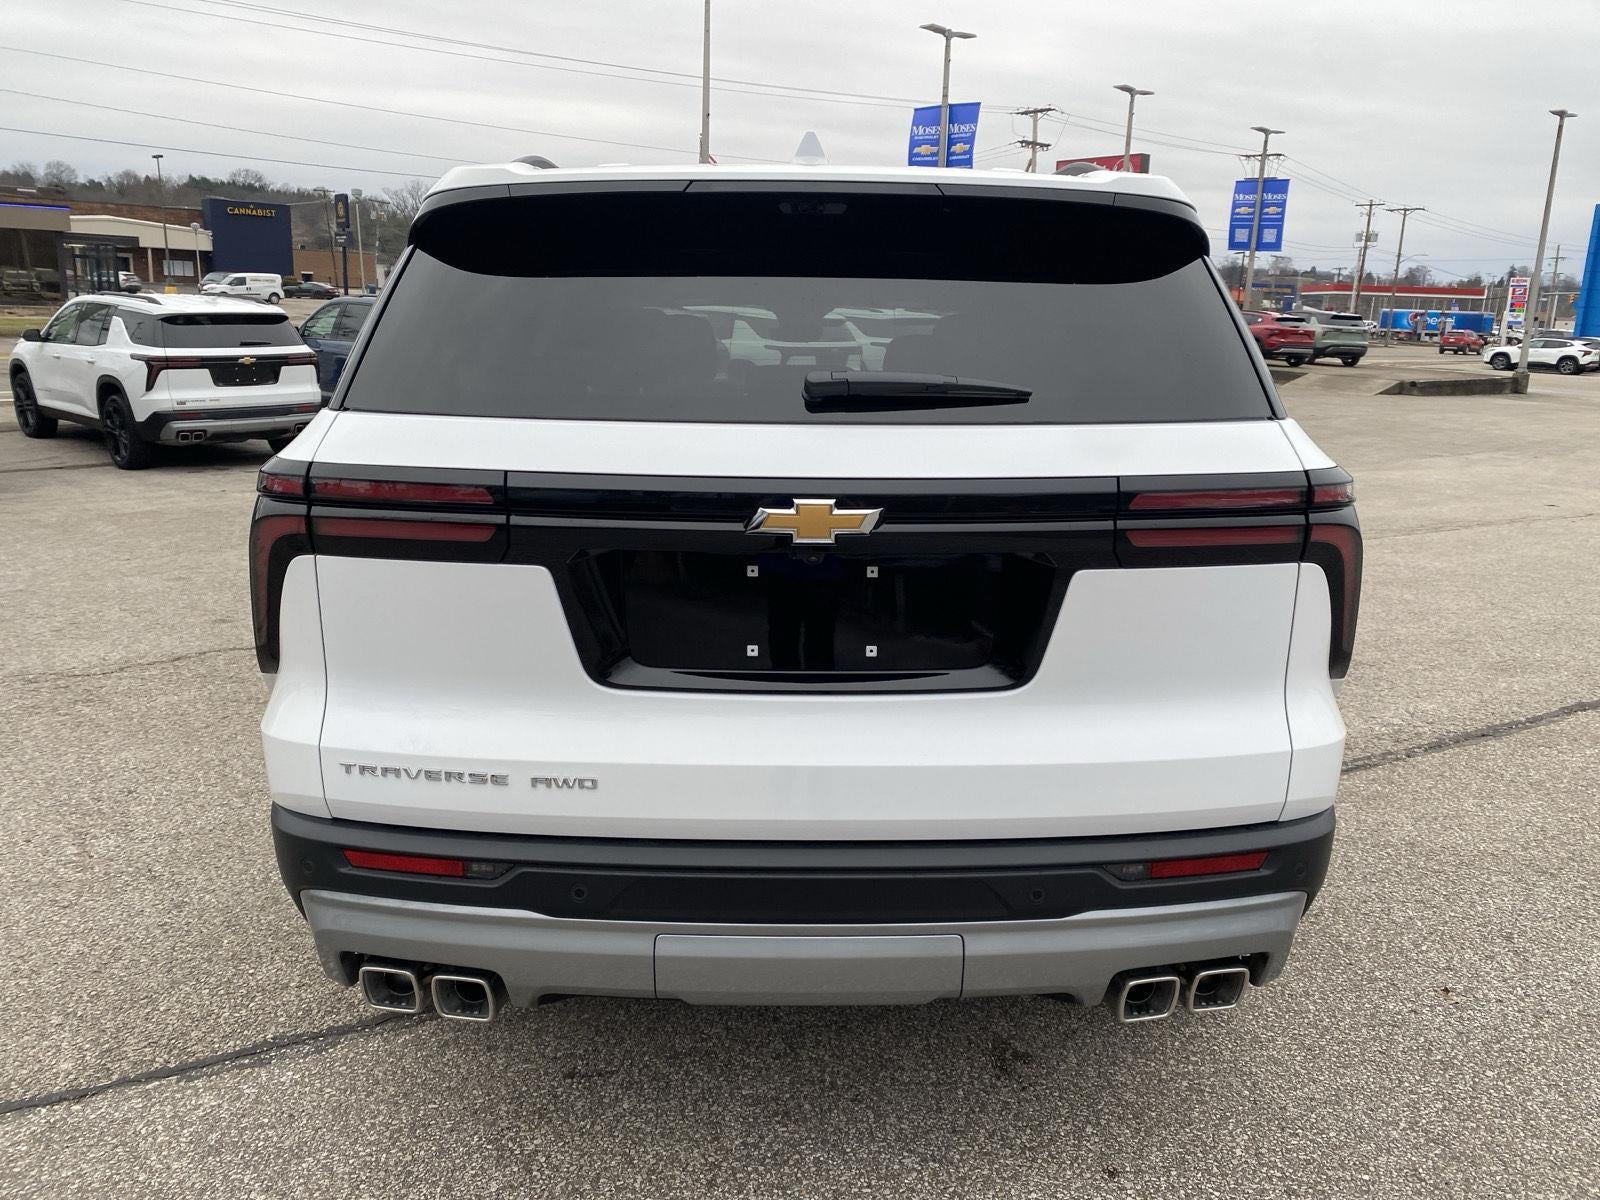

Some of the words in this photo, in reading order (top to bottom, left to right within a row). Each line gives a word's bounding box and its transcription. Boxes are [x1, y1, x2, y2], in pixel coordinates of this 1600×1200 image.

[949, 123, 976, 134] MOSES
[1263, 192, 1287, 200] MOSES
[227, 207, 276, 217] CANNABIST
[338, 762, 509, 786] TRAVERSE
[530, 776, 599, 790] AWD
